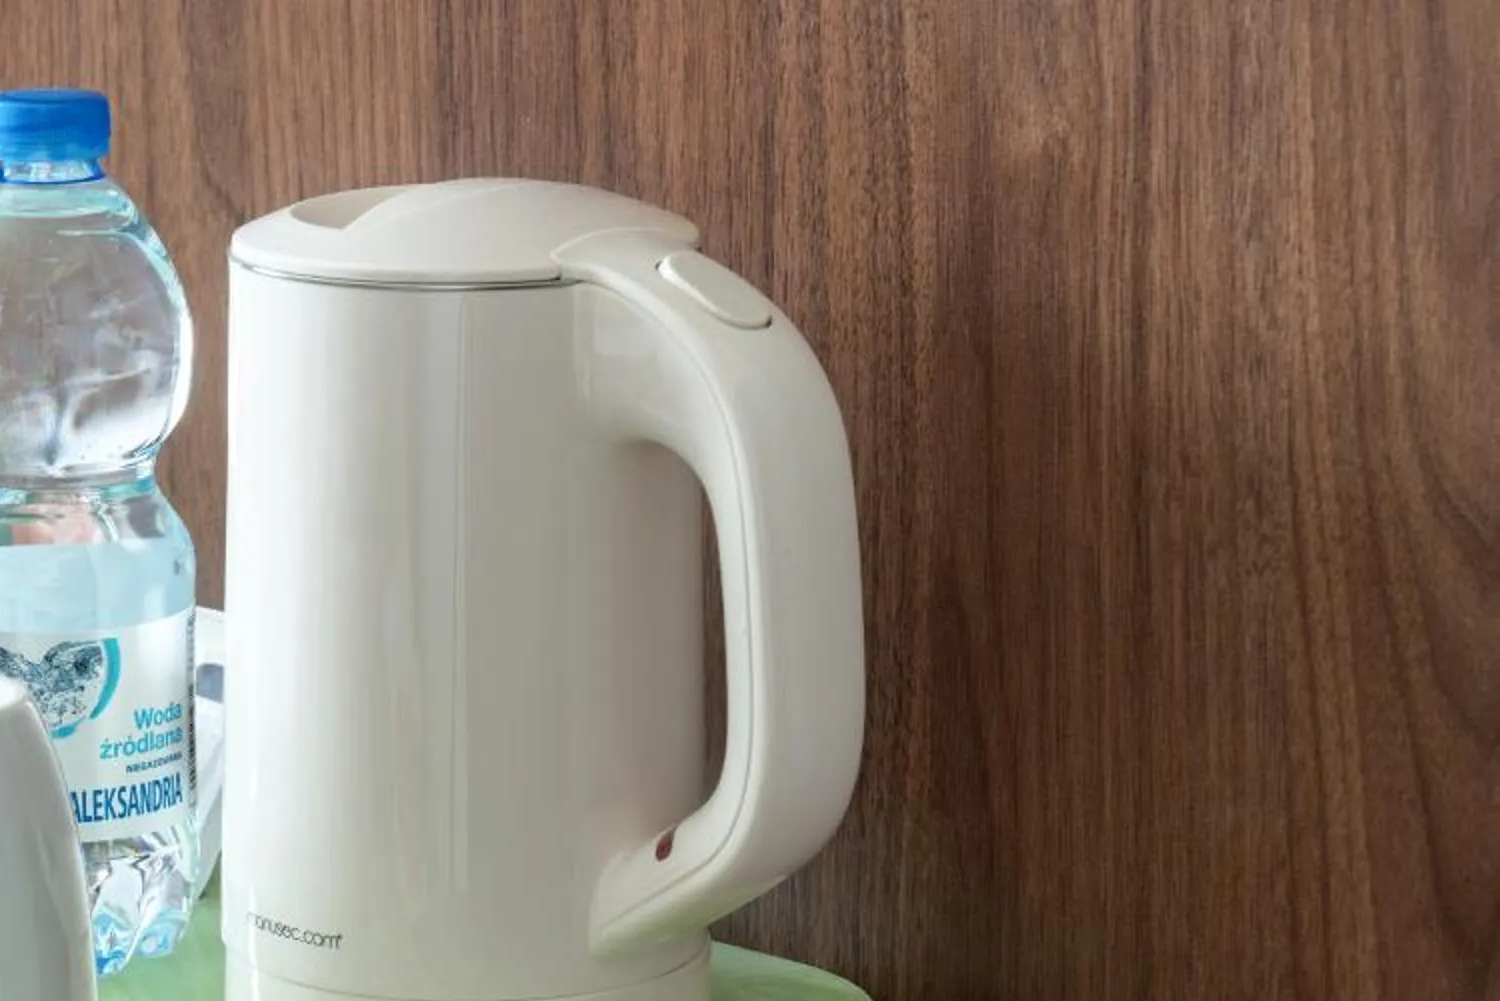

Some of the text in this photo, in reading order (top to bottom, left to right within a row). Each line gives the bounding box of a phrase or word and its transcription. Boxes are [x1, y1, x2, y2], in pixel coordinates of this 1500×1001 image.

[134, 702, 182, 729] Woda
[99, 728, 182, 760] źródlana
[71, 773, 182, 823] ALEKSANDRIA
